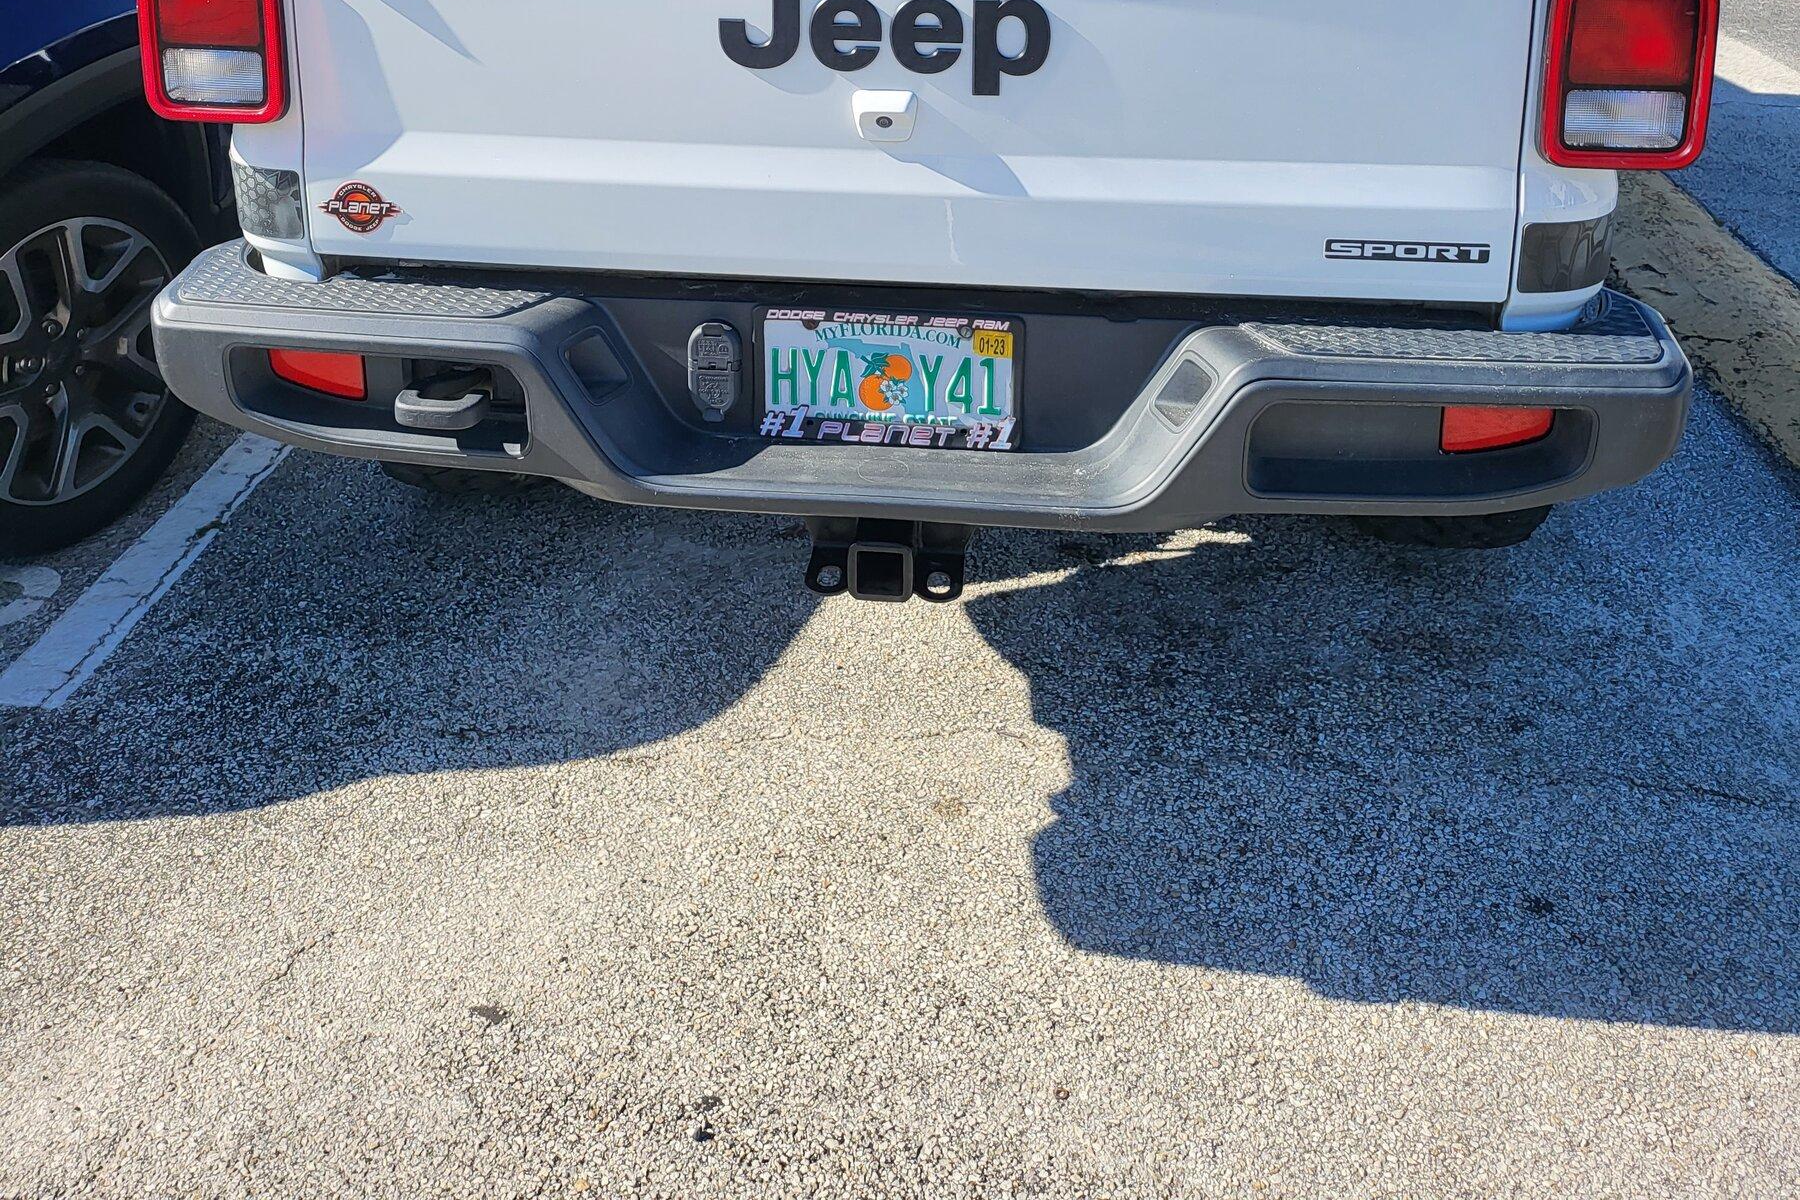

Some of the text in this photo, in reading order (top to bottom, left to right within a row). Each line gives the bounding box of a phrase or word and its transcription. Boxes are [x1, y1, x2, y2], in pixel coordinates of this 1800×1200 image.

[328, 201, 390, 215] PLANET
[1325, 241, 1490, 261] SPORT
[766, 308, 1010, 331] DODGE CHRYSLER JEEP RAM
[979, 336, 1005, 356] 01-23
[771, 347, 855, 407] HYA
[918, 354, 1002, 416] Y41
[760, 404, 1016, 450] #1 PLANET #1
